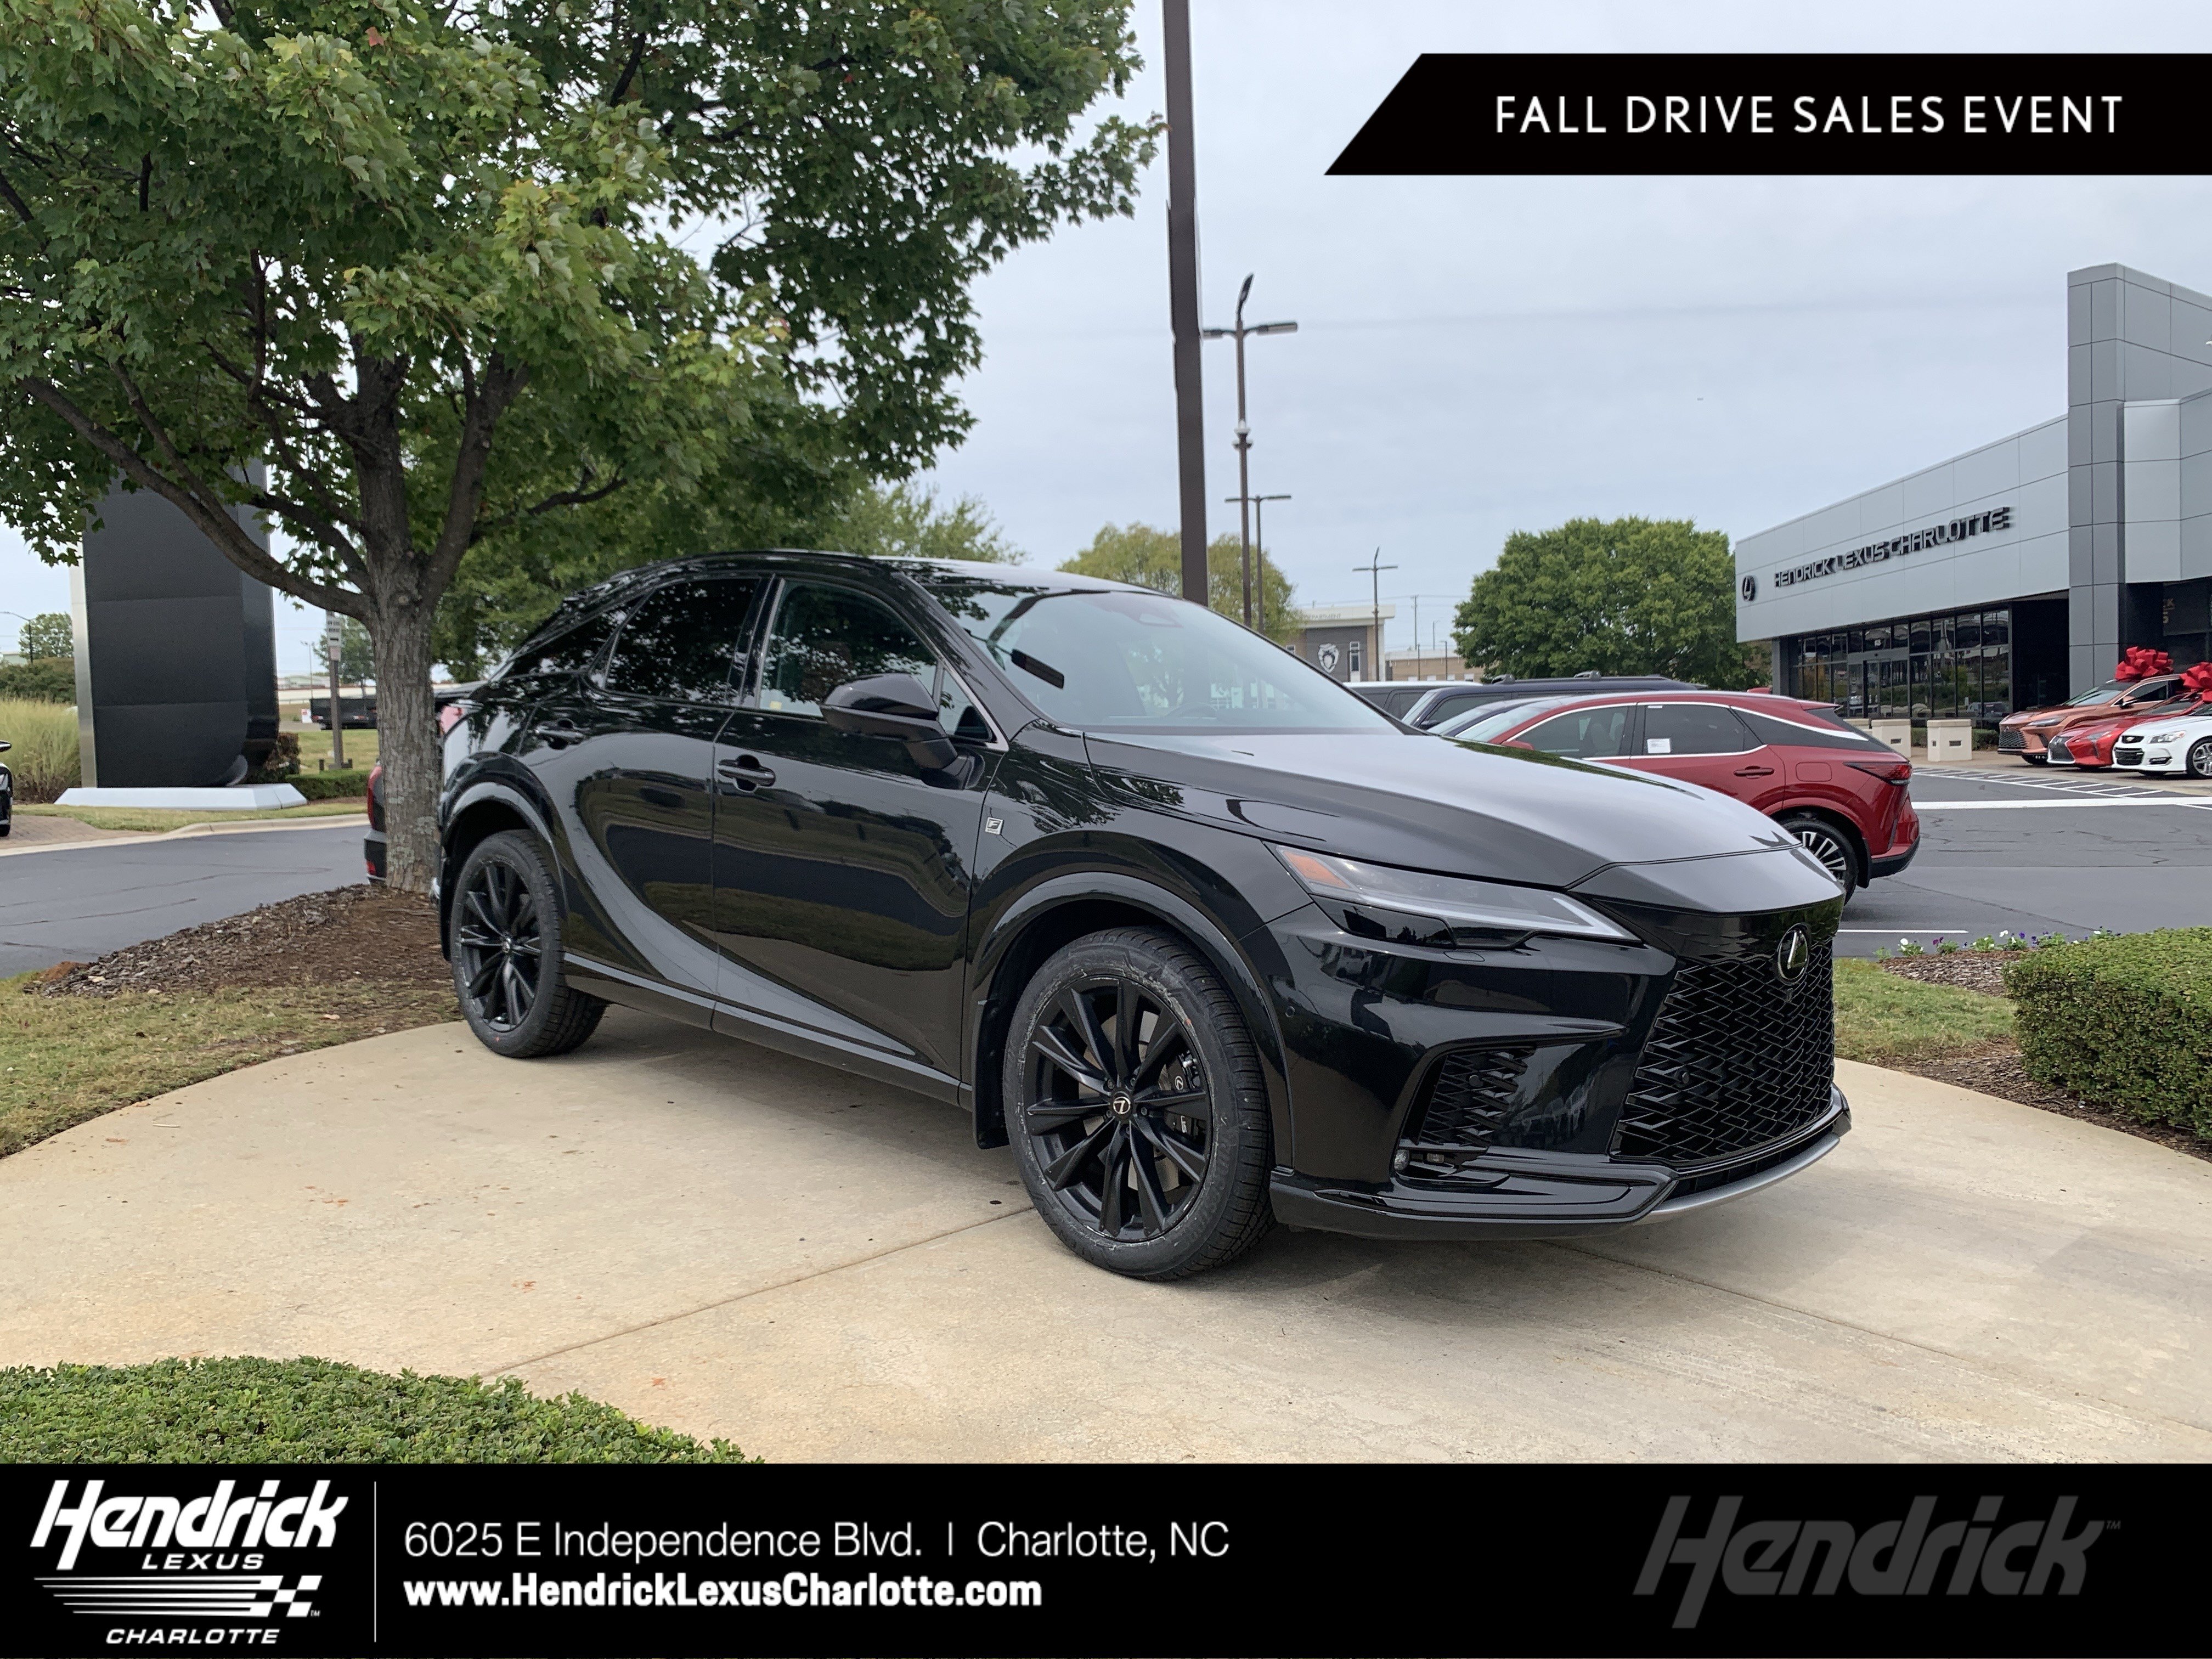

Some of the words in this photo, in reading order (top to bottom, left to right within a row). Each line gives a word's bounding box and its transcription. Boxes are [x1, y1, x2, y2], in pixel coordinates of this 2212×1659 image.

[1774, 558, 1835, 587] HENDRICK
[1834, 541, 1888, 571] LEXUS
[1889, 506, 2011, 556] CHARLOTTE
